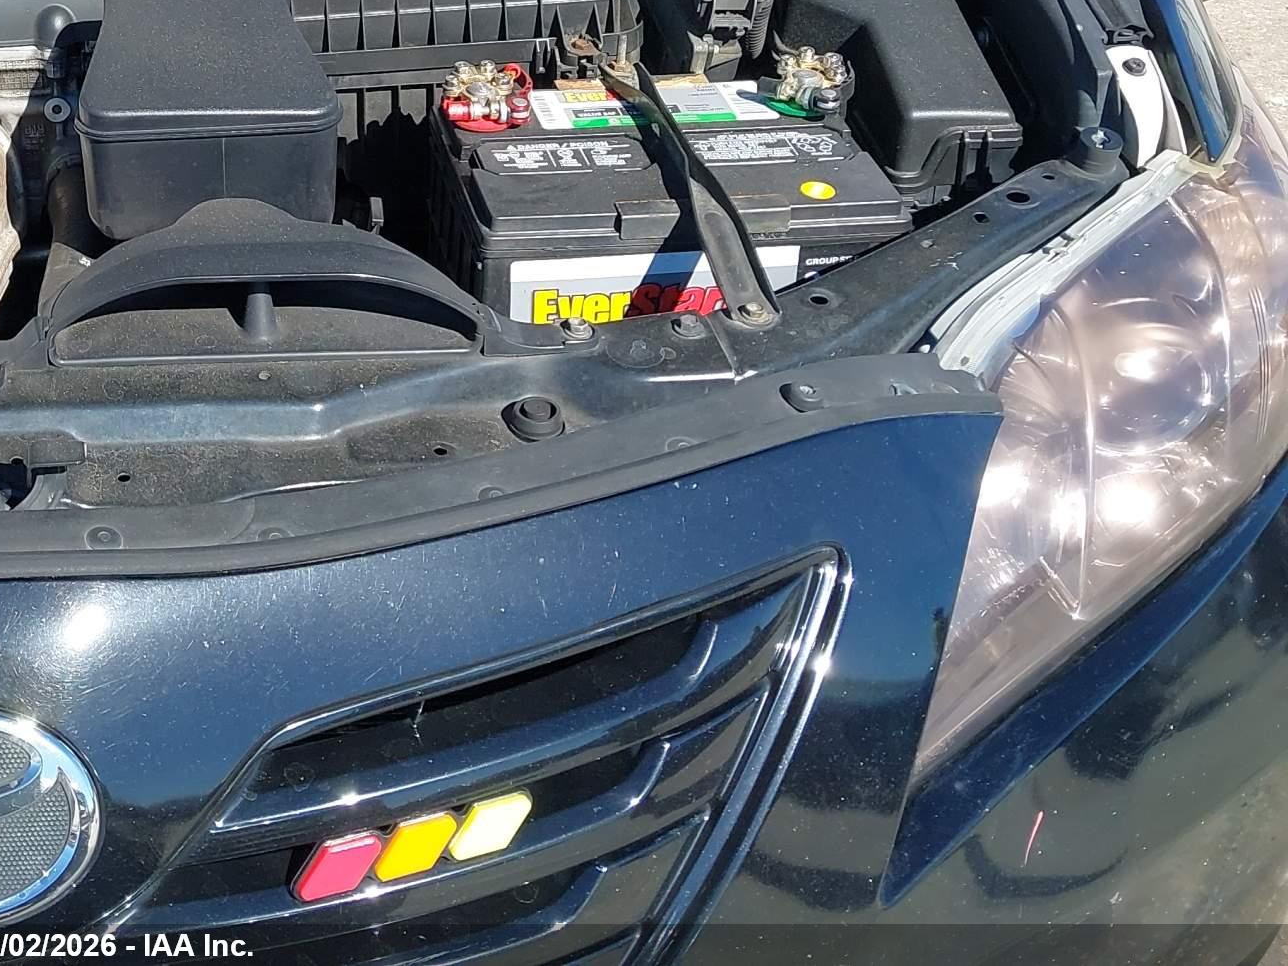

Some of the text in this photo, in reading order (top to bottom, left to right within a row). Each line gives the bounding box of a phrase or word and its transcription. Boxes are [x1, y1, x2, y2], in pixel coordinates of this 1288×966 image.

[516, 143, 561, 151] DANGER
[569, 141, 609, 149] POISON
[805, 256, 839, 266] GROUP
[531, 283, 728, 326] EverStar
